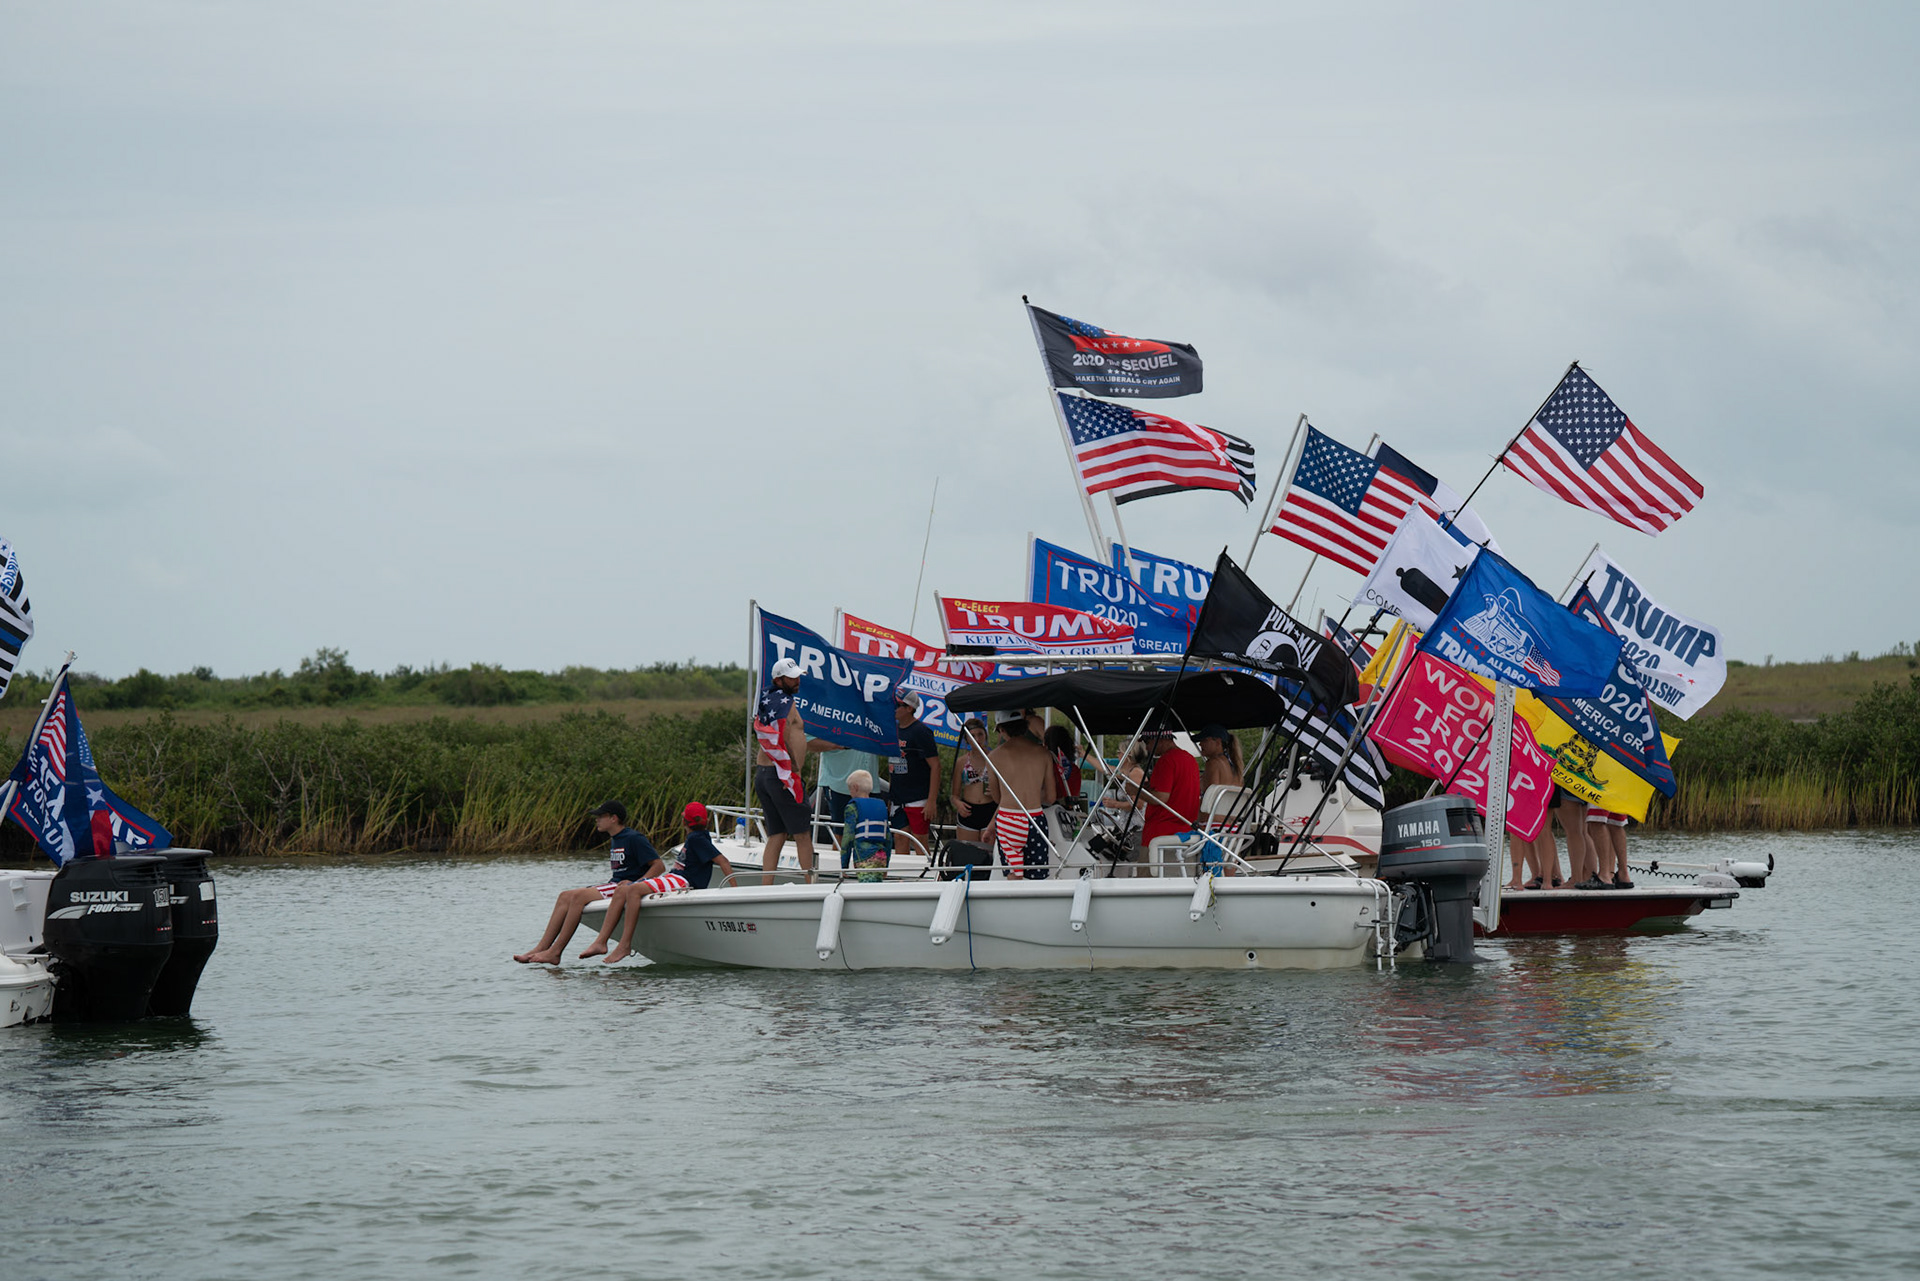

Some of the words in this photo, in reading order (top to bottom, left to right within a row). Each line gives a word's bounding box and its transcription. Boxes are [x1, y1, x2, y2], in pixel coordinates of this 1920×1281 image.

[1072, 353, 1105, 367] 2020
[1121, 353, 1178, 371] SEQUEL
[1158, 375, 1181, 385] AGAIN
[1124, 556, 1211, 600] TRU
[1600, 563, 1716, 668] TRUMP
[965, 635, 1003, 645] KEEP
[1138, 638, 1182, 653] GREAT!
[1257, 605, 1295, 635] POW
[1297, 632, 1323, 672] MIA
[1485, 632, 1527, 663] 2020
[1435, 630, 1497, 681] TRUMP
[1486, 656, 1504, 672] ALL
[810, 702, 862, 726] AMERICA
[831, 727, 842, 736] 45
[1551, 768, 1574, 784] READ
[1573, 783, 1588, 795] ON
[1587, 791, 1602, 804] ME
[1397, 820, 1441, 838] YAMAHA
[1420, 838, 1441, 848] 150
[69, 890, 129, 903] SUZUKI
